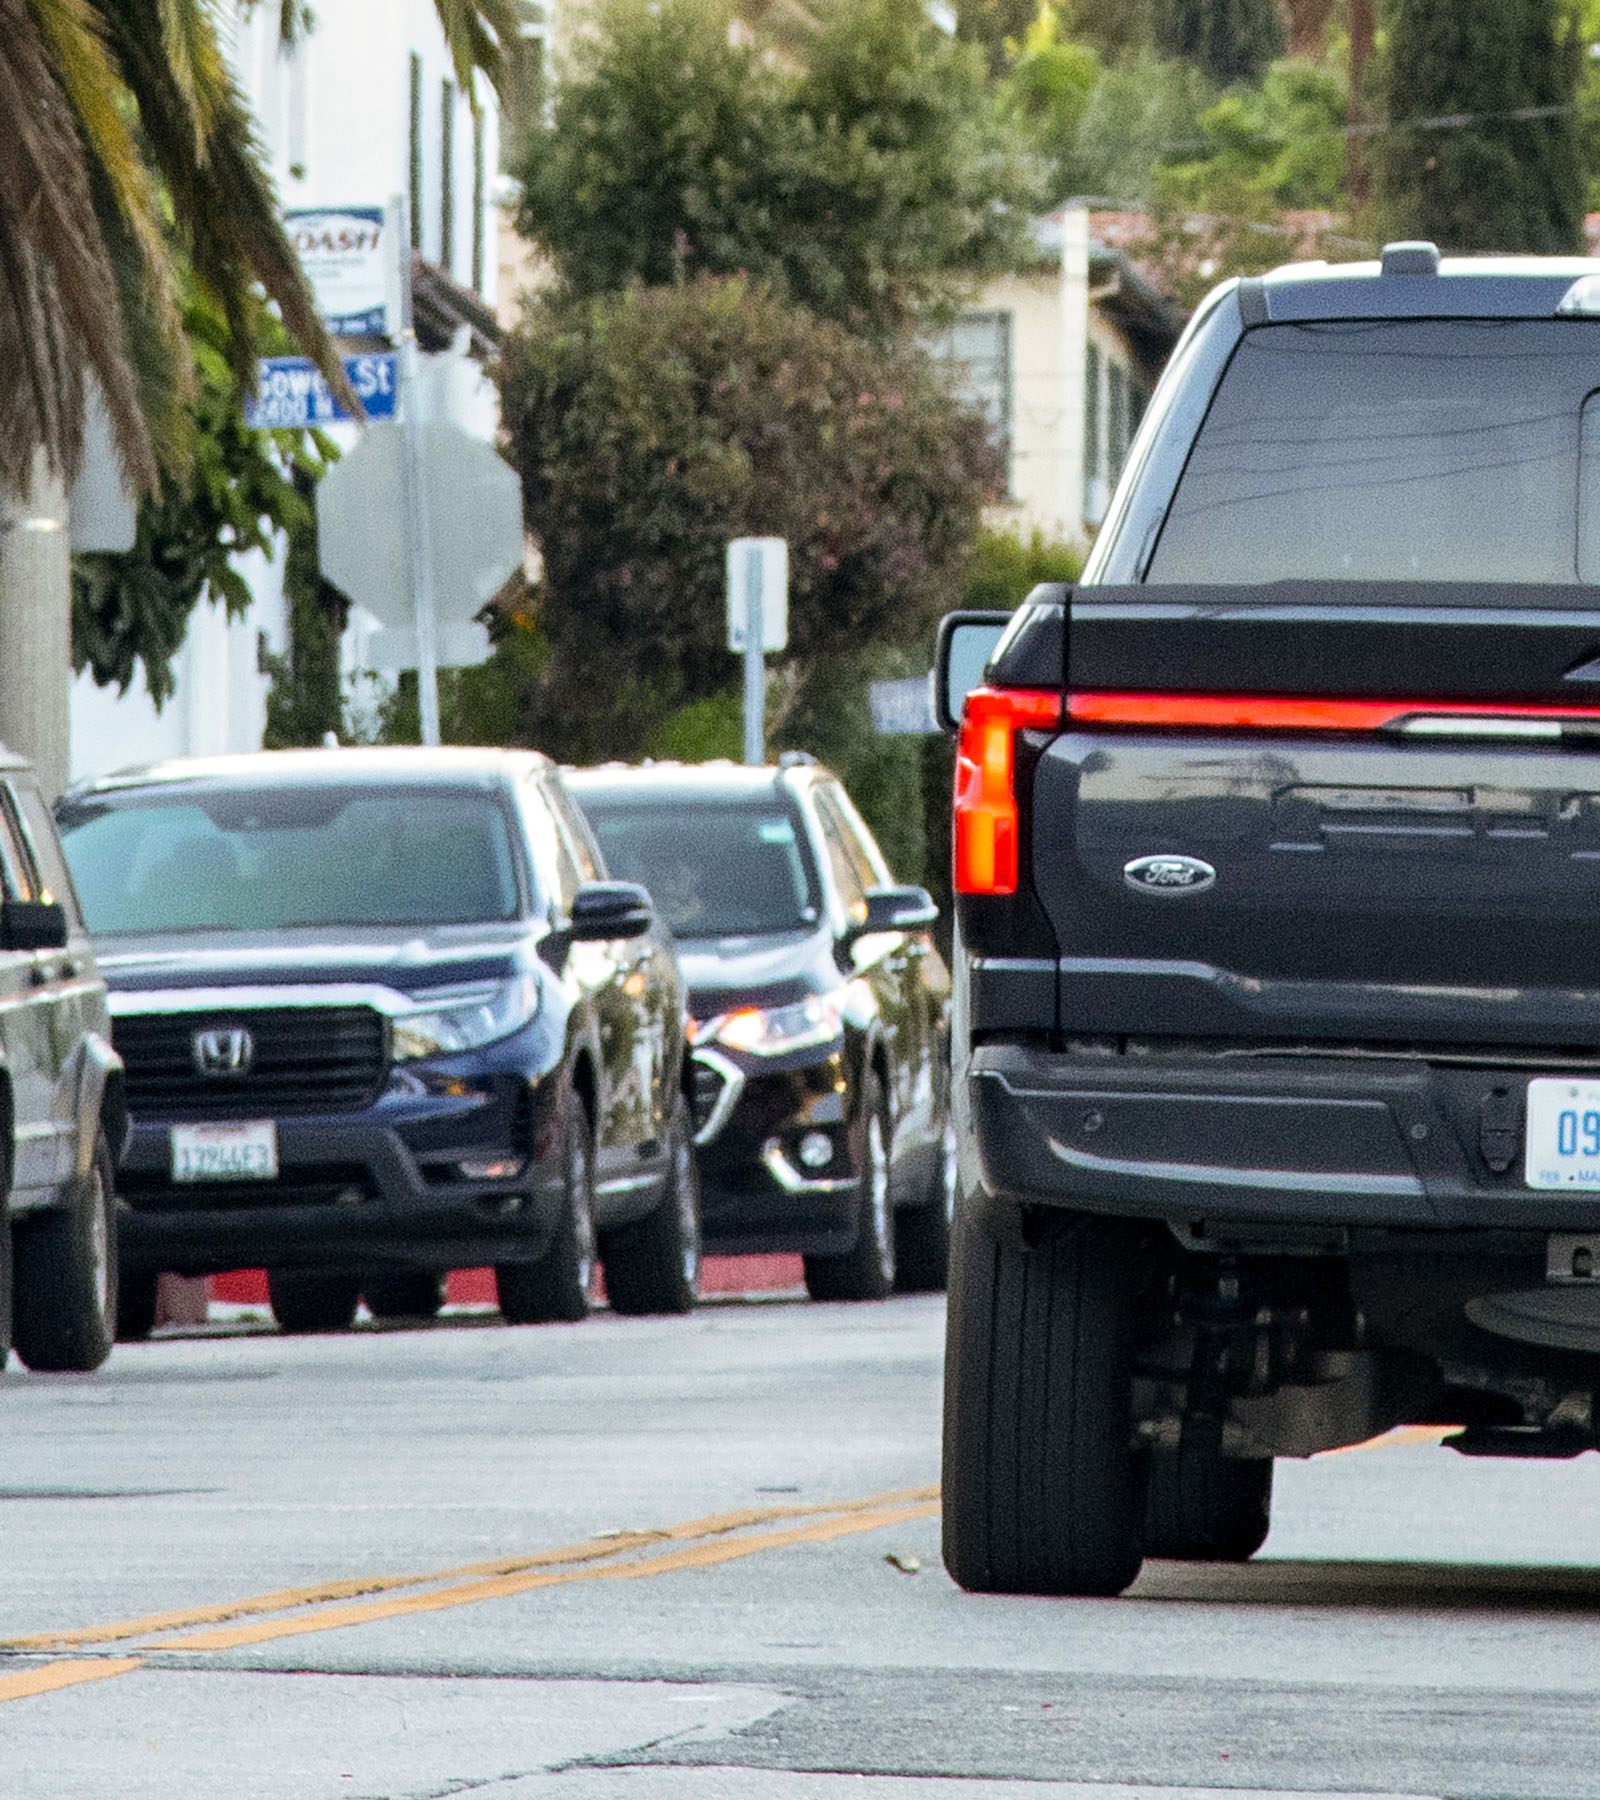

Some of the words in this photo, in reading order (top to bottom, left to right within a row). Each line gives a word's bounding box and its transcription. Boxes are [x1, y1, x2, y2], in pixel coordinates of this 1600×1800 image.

[356, 359, 392, 398] St
[315, 398, 334, 419] N
[1144, 861, 1195, 885] Ford
